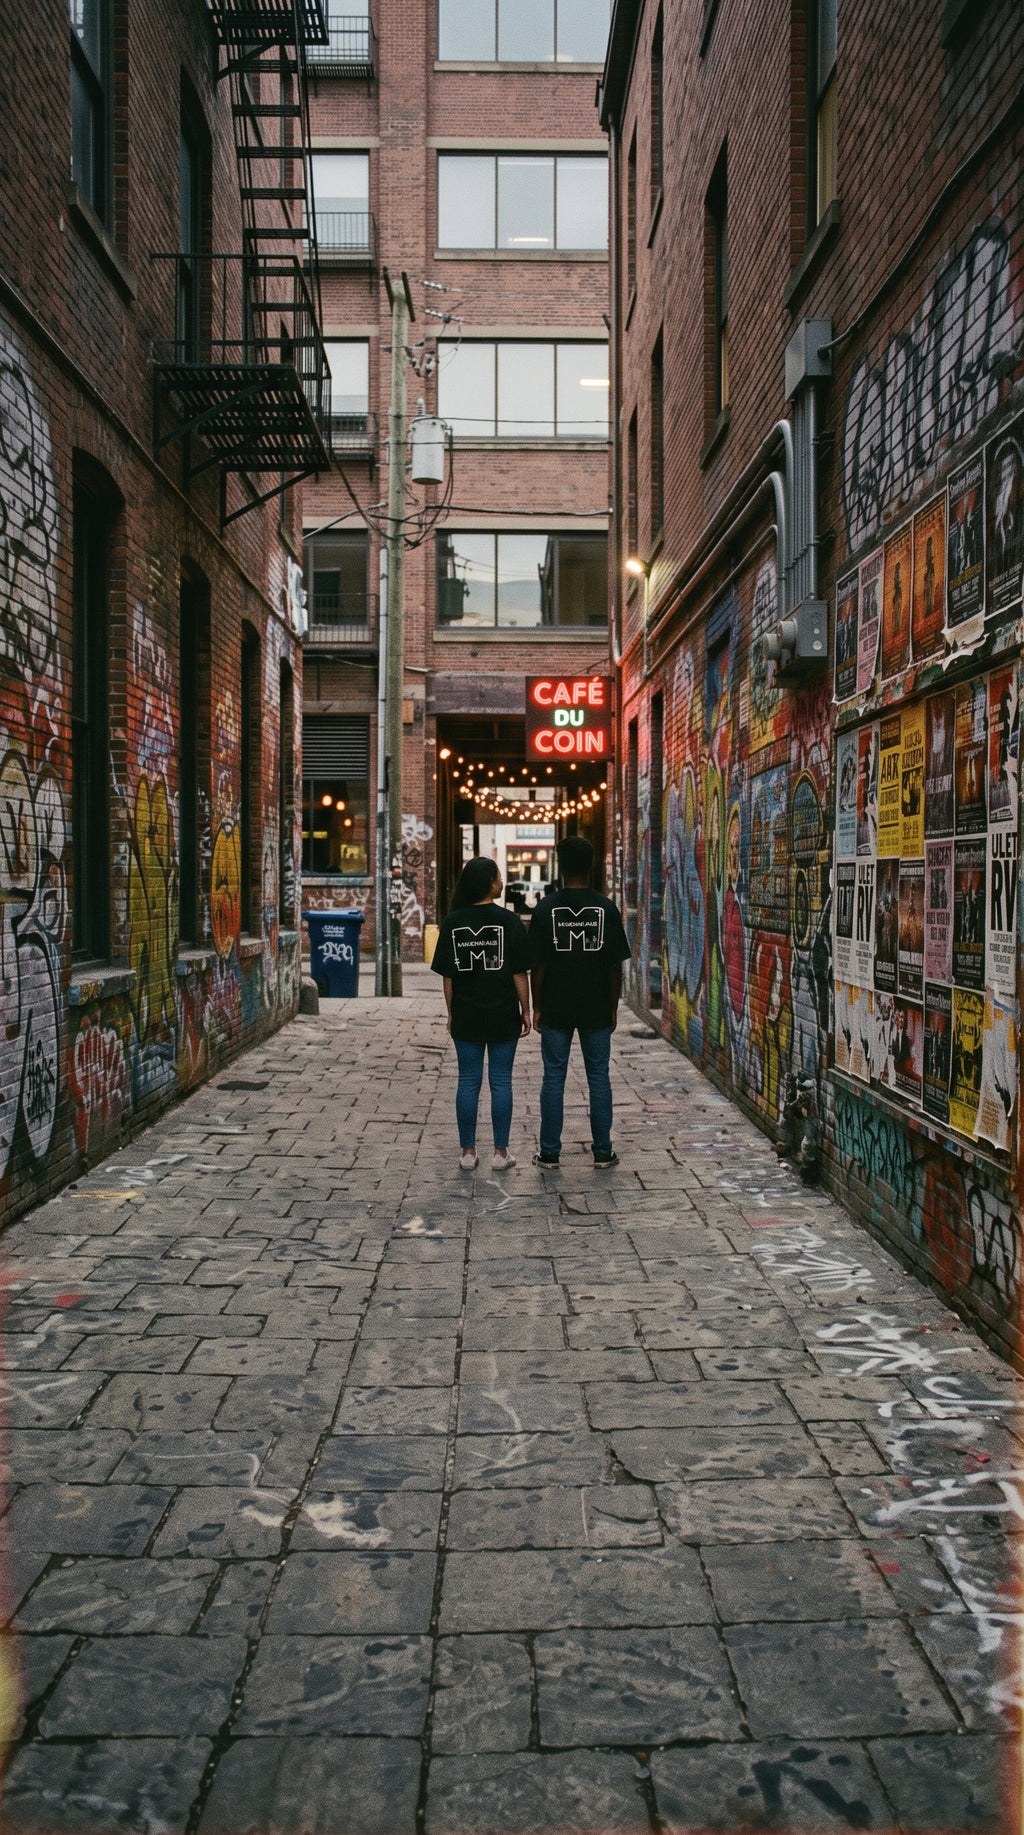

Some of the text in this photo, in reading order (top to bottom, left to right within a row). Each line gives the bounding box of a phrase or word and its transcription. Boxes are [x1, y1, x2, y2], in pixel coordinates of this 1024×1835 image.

[533, 676, 604, 705] CAFÉ
[554, 709, 585, 727] DU
[534, 730, 604, 753] COIN
